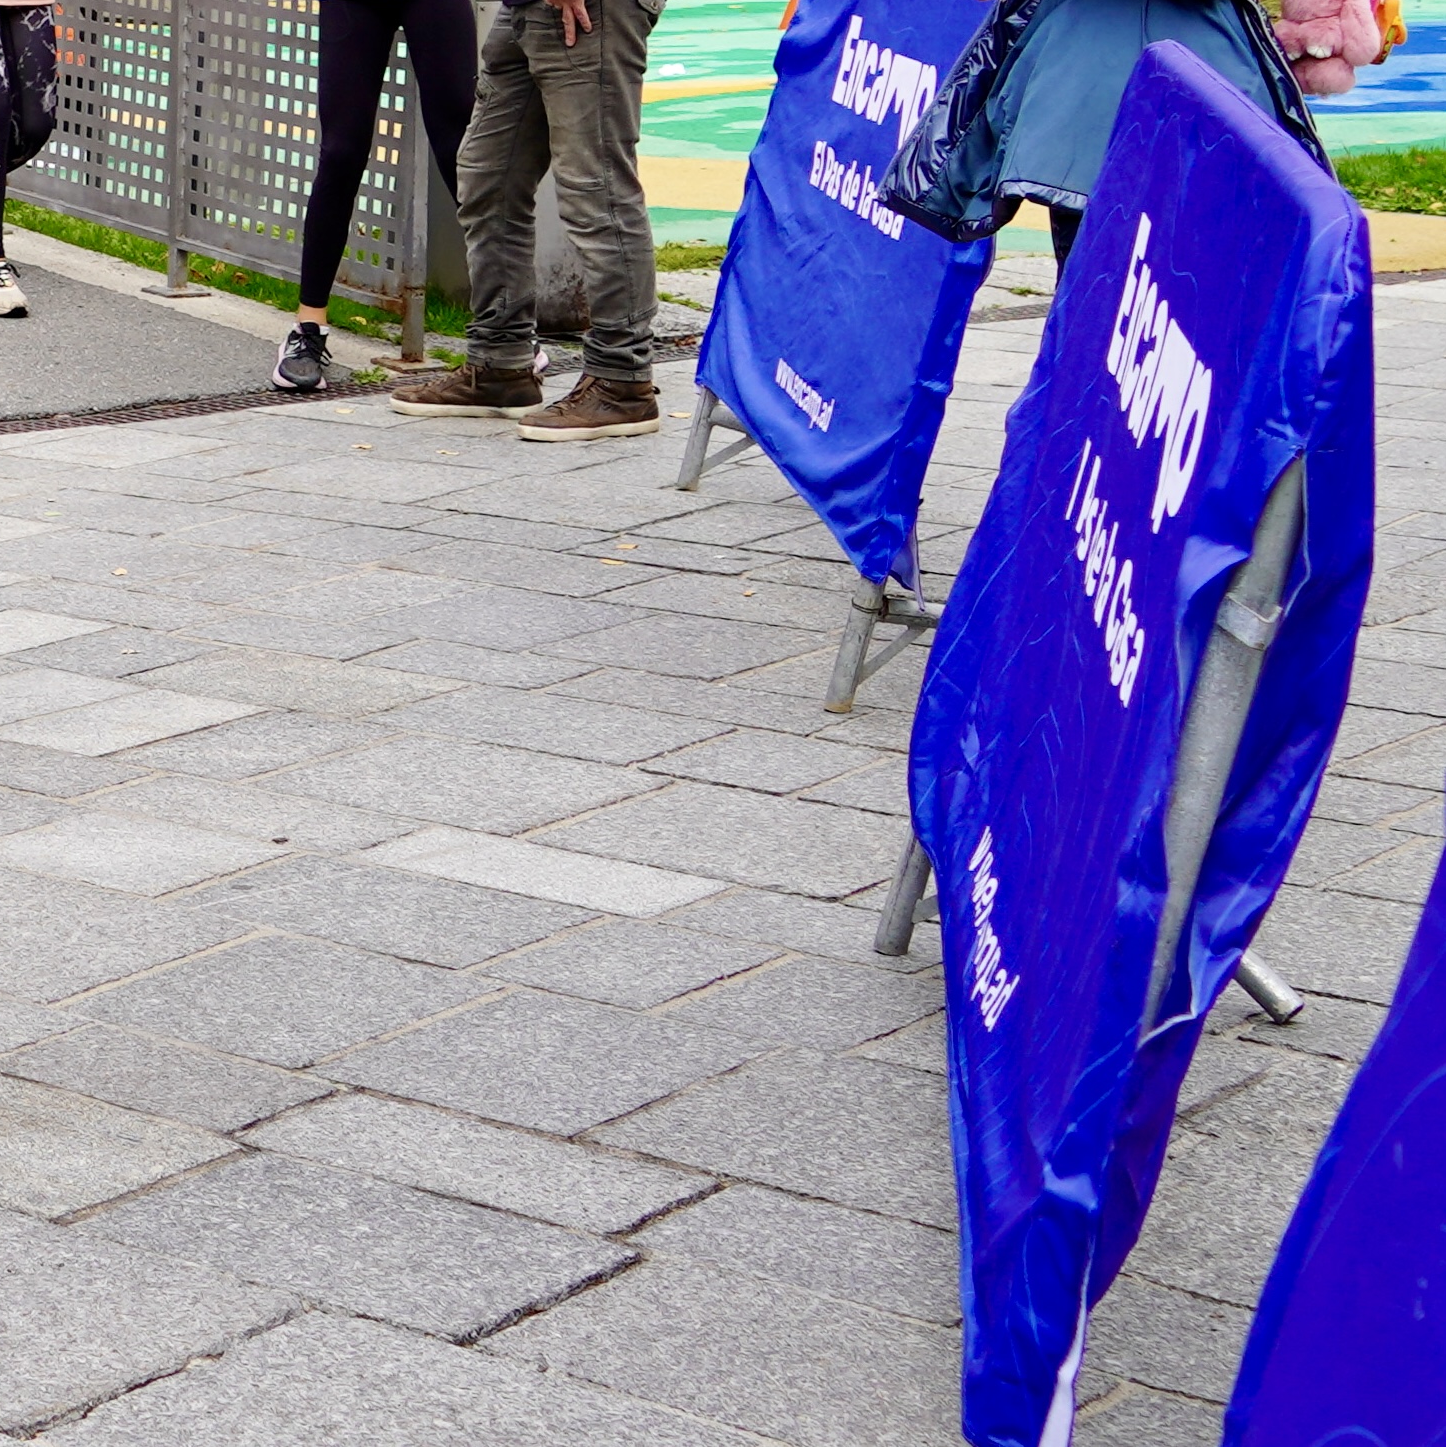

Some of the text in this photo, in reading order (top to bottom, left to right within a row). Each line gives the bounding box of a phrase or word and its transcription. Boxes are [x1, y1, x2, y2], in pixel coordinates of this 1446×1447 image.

[809, 140, 828, 189] El
[819, 146, 845, 201] Pas
[840, 160, 861, 211] de
[856, 165, 876, 220] la
[1106, 212, 1213, 535] Encamp
